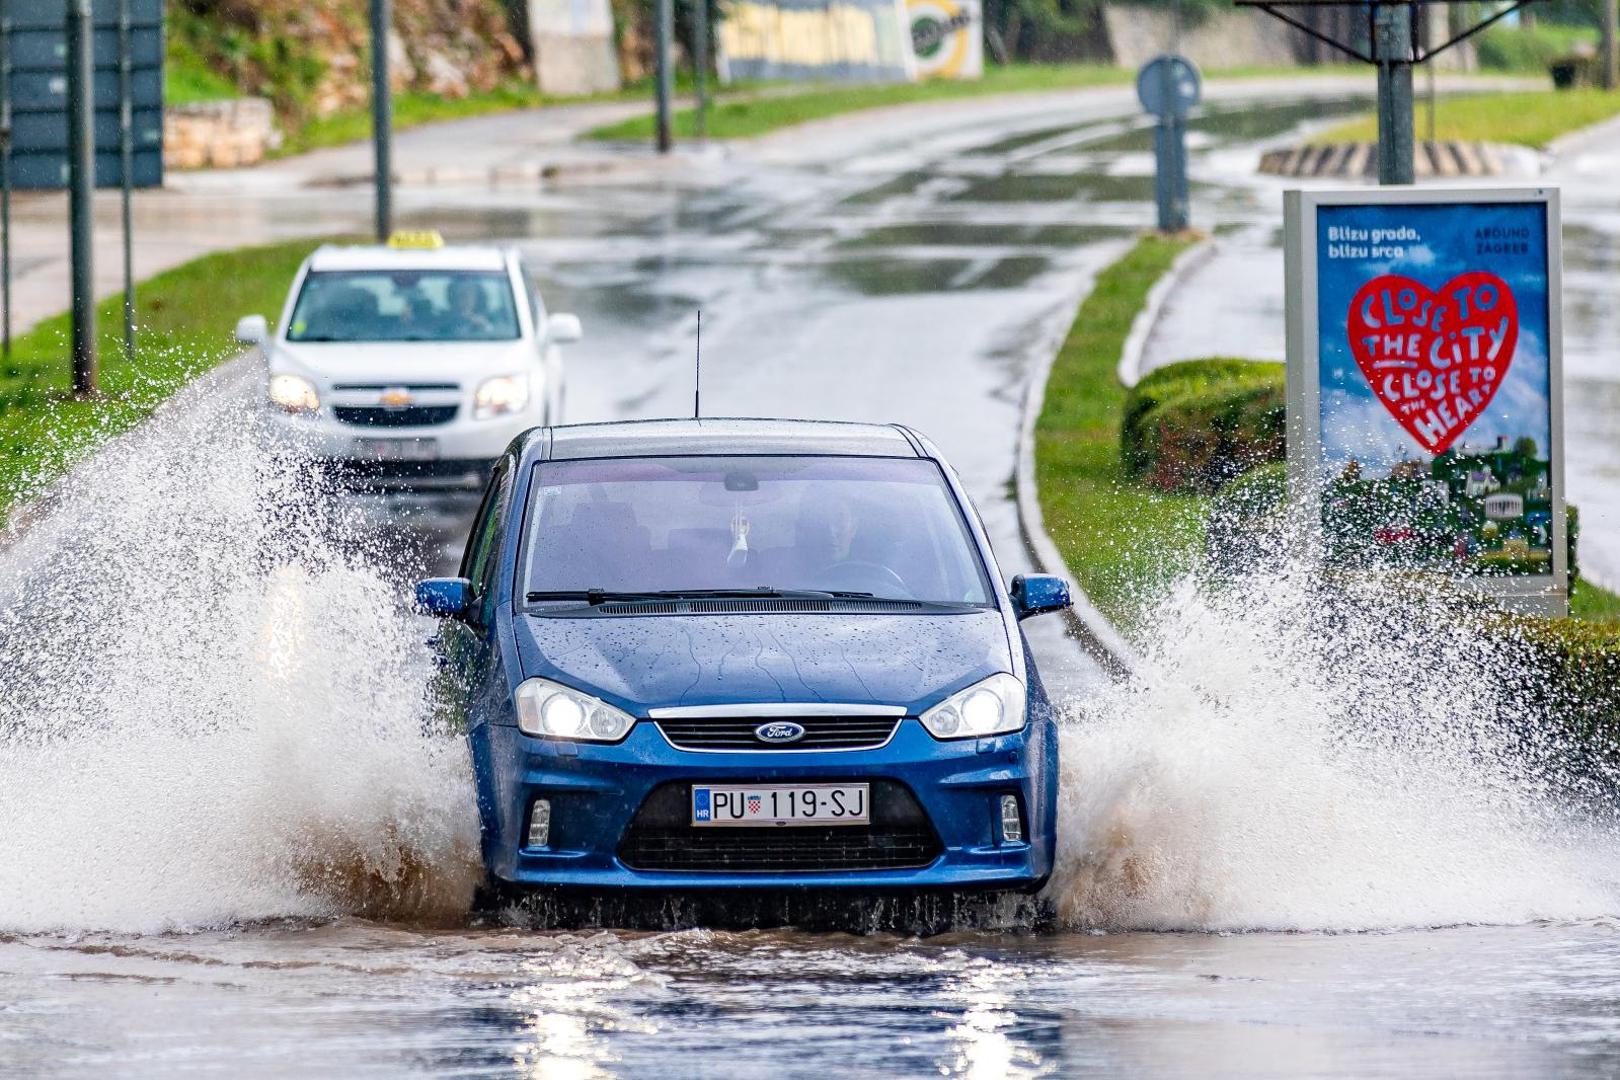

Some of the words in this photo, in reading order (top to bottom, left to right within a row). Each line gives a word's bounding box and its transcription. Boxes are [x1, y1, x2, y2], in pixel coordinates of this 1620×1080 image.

[1328, 226, 1368, 241] Blizu
[1328, 244, 1368, 258] blizu
[1371, 246, 1404, 258] srca
[1361, 288, 1447, 332] CLOSE
[1453, 283, 1499, 320] TO
[1362, 333, 1422, 357] THE
[1382, 369, 1461, 400] CLOSE
[1469, 366, 1496, 383] TO
[1401, 400, 1426, 415] THE
[1413, 384, 1492, 446] HEART
[767, 725, 793, 738] Ford
[696, 809, 709, 818] HR
[713, 792, 745, 819] PU
